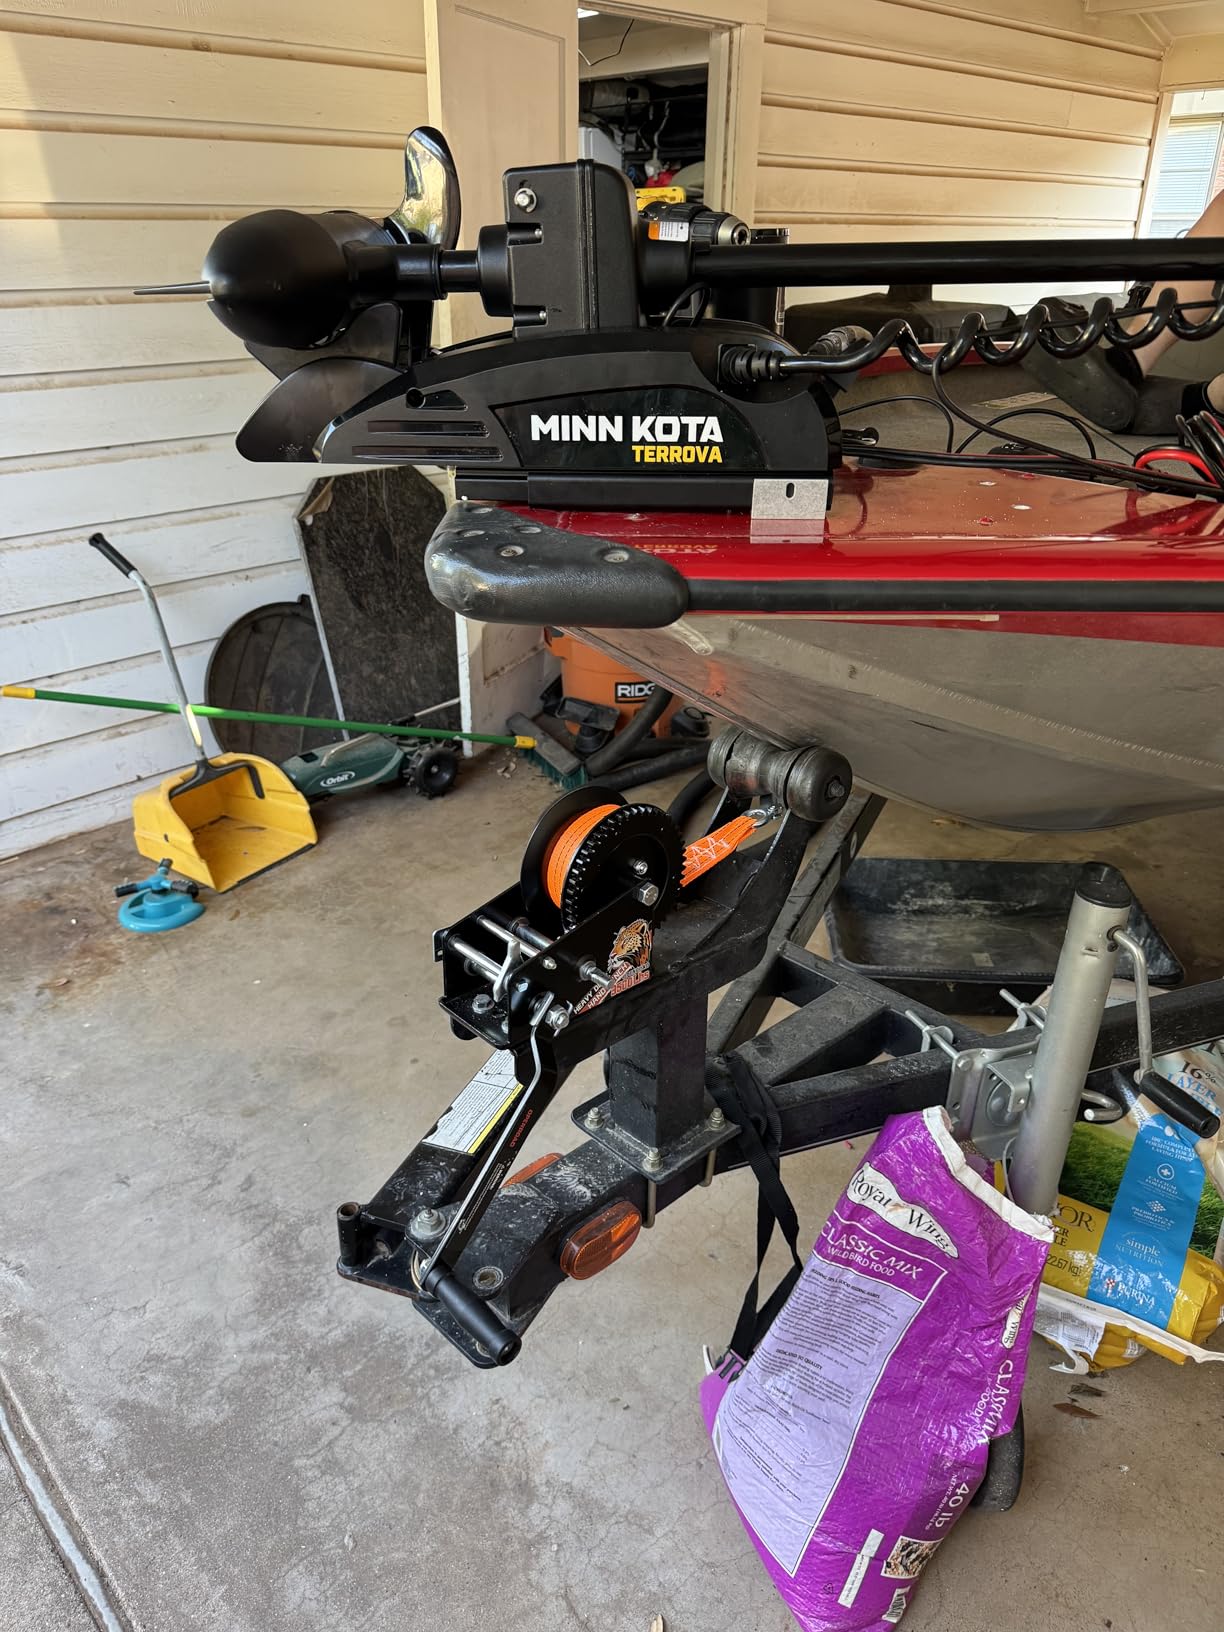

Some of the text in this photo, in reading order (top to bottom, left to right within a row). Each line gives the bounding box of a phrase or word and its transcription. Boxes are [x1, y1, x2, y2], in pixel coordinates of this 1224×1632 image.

[531, 415, 723, 442] MINN KOTA
[632, 445, 723, 463] TERROVA
[326, 774, 349, 785] Orbit
[573, 991, 594, 1014] HEAVY
[587, 987, 606, 1009] HAND
[510, 1109, 533, 1148] OPENROAD
[852, 1170, 949, 1249] Royal Wing
[821, 1221, 923, 1280] CLASSIC MIX
[1115, 1243, 1164, 1267] NUTRITION
[1126, 1237, 1160, 1257] simple
[869, 1262, 895, 1277] FOOD
[1118, 1281, 1156, 1308] PURINA
[935, 1482, 970, 1528] 40 lb
